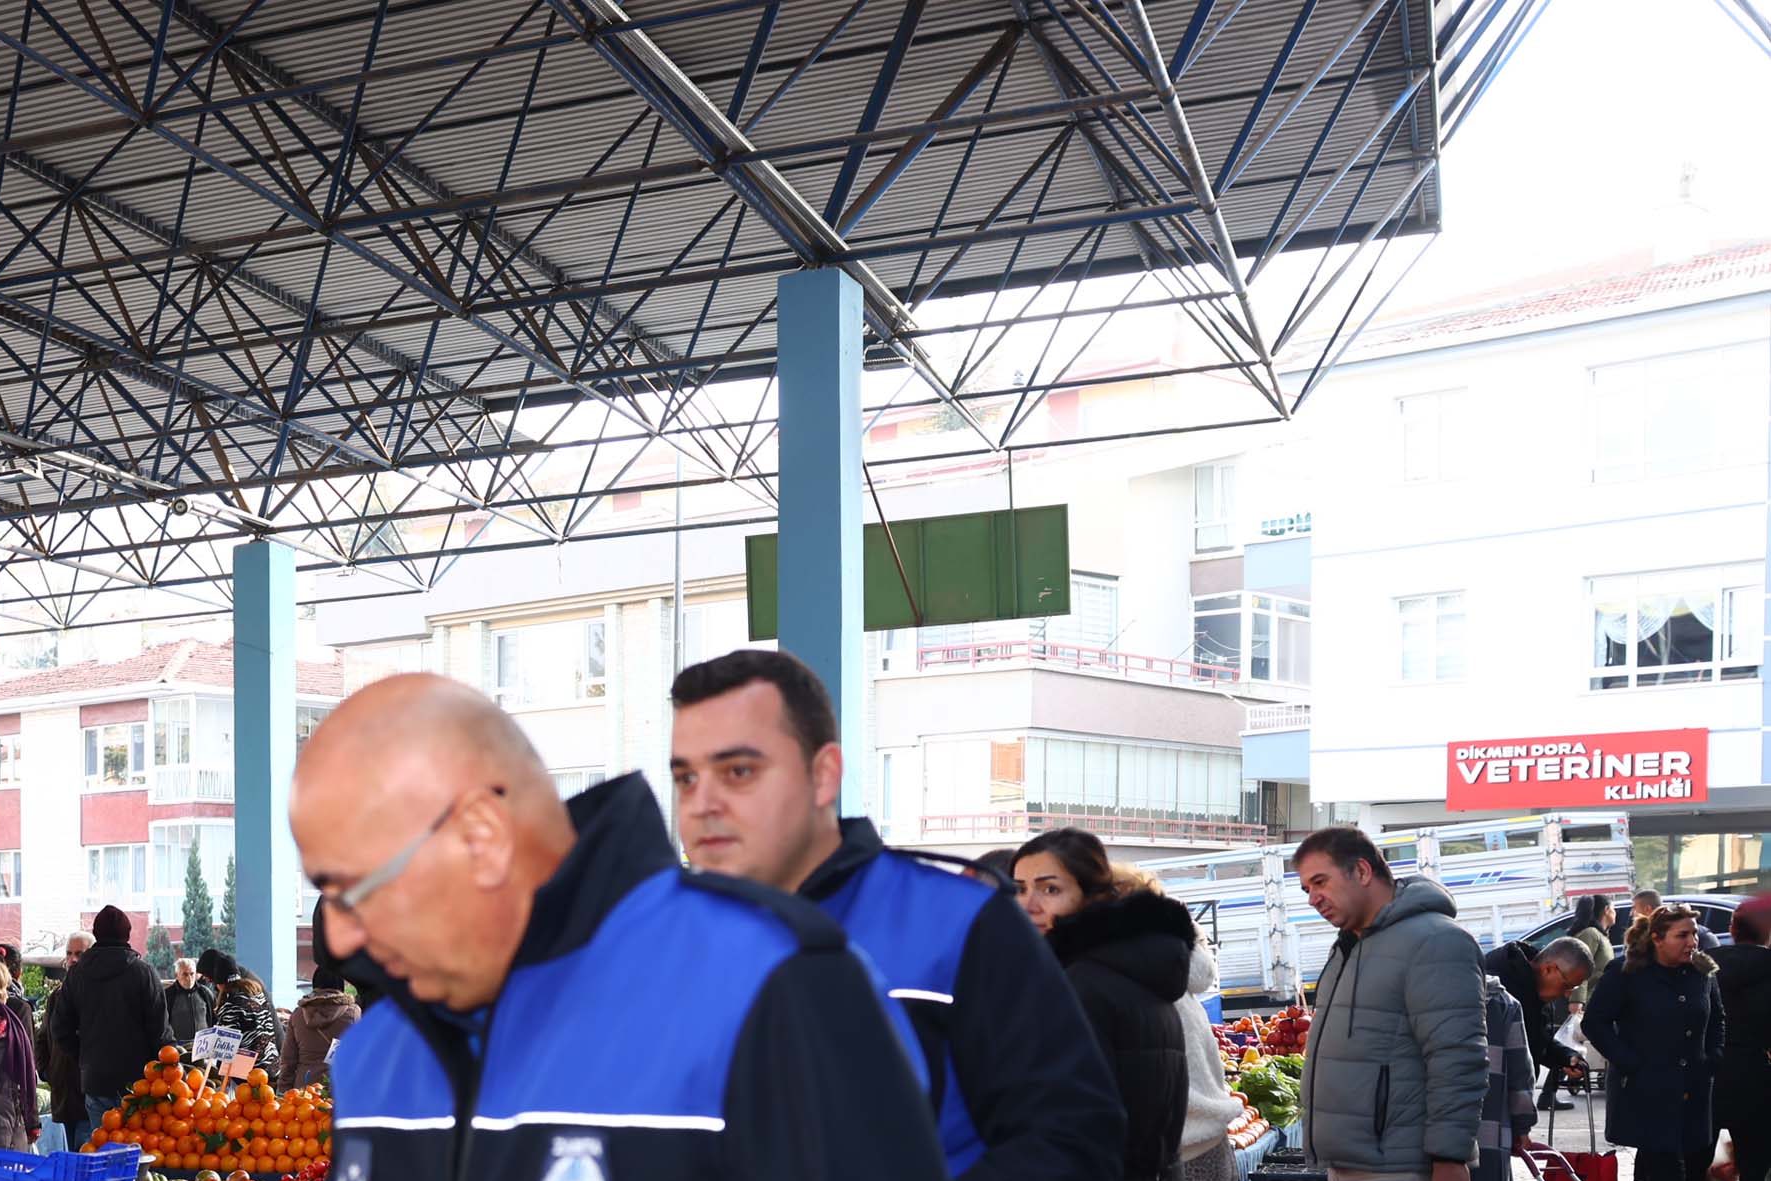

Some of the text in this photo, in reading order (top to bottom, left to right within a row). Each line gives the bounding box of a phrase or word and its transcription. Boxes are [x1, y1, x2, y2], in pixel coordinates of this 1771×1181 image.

[1456, 742, 1587, 760] DİKMEN DORA
[1456, 749, 1692, 784] VETERİNER
[1604, 778, 1692, 800] KLİNİĞİ
